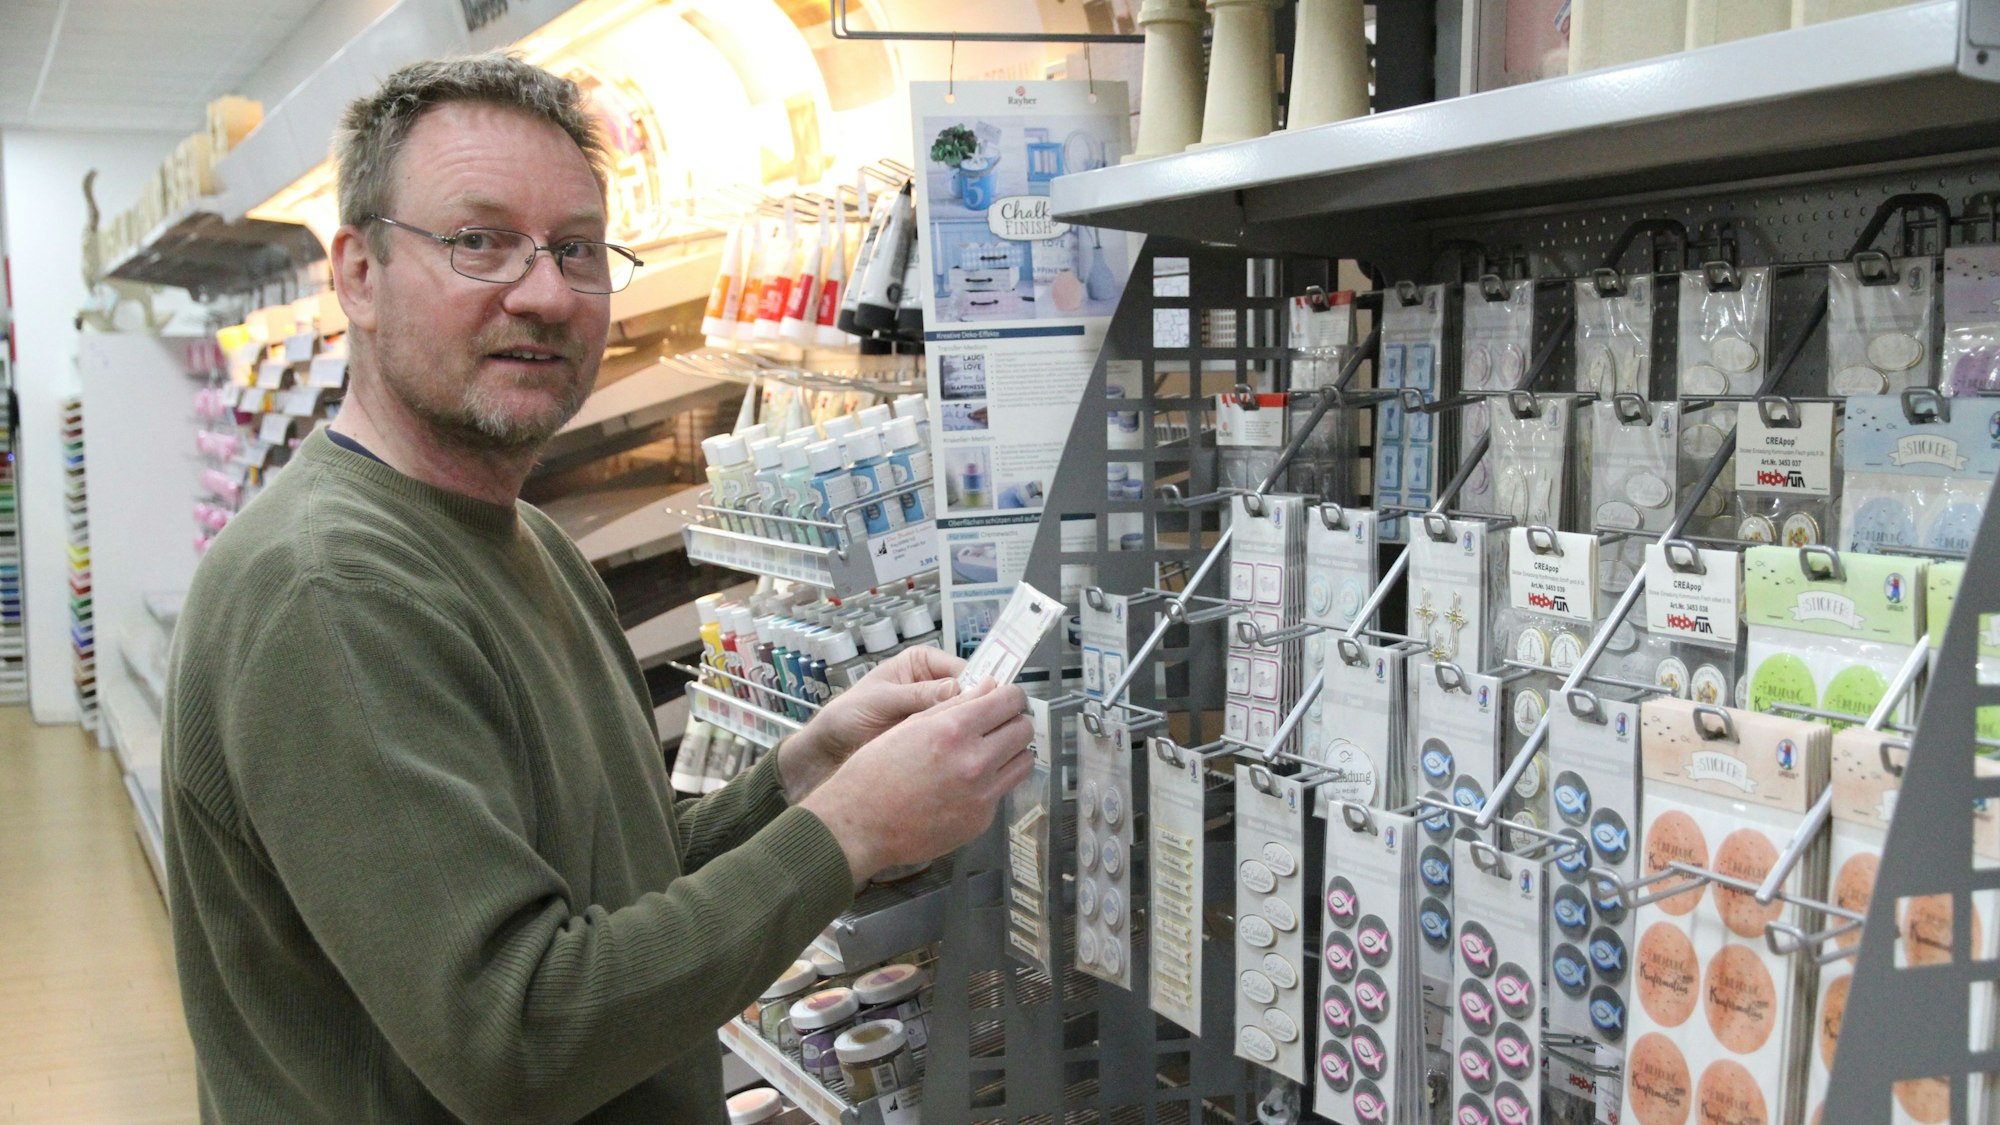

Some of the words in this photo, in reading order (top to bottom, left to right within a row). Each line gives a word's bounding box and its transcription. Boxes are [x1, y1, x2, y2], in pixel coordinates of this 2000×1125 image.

[1007, 96, 1037, 106] Rayher
[1001, 200, 1050, 220] Chalk
[1765, 437, 1795, 446] CREApop
[1533, 562, 1559, 574] CREApop
[1673, 580, 1702, 592] CREApop
